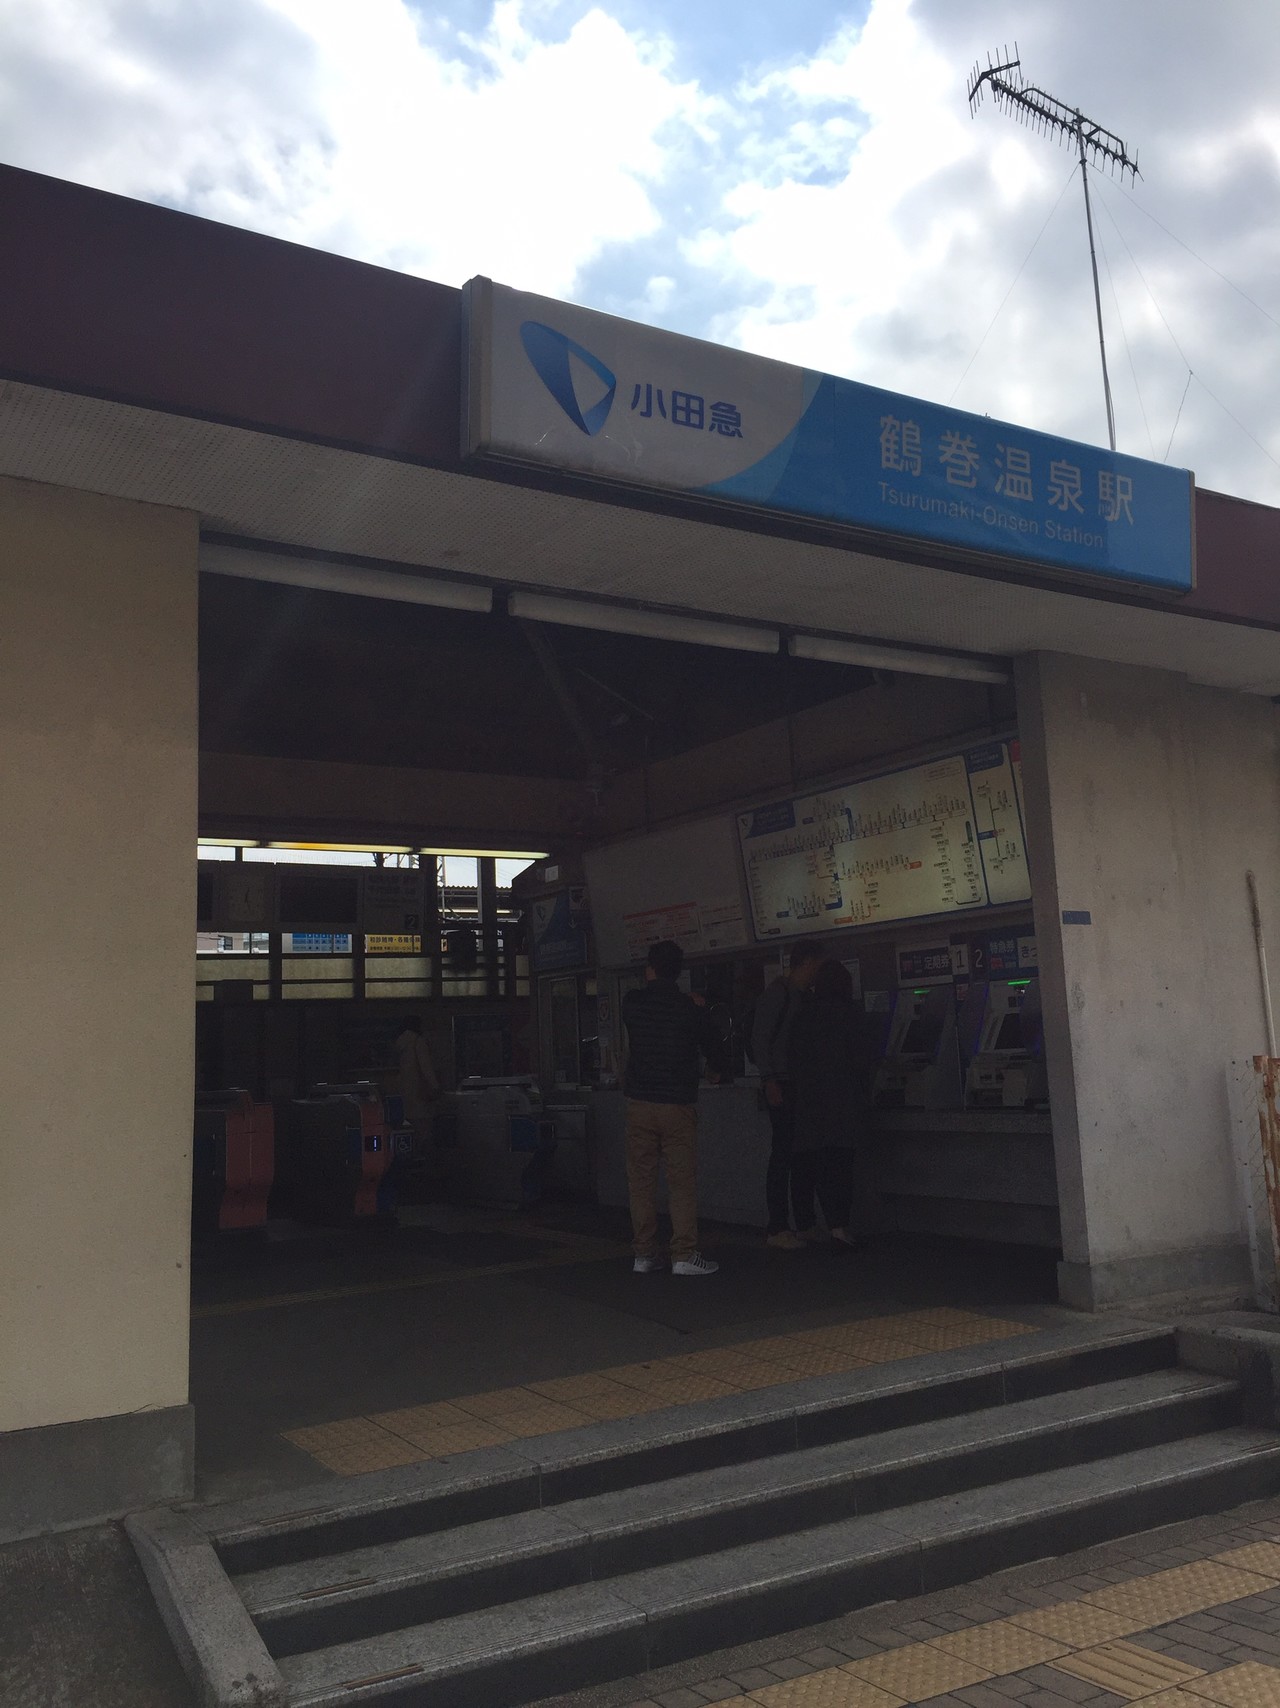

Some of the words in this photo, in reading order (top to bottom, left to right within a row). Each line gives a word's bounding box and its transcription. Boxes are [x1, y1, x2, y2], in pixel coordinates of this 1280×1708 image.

[631, 384, 743, 438] 小田急
[879, 414, 1135, 526] 鶴巻温泉駅
[877, 480, 1040, 536] Tsurumaki-Onsen
[1044, 519, 1105, 549] Station
[956, 950, 966, 969] 1
[974, 949, 984, 968] 2
